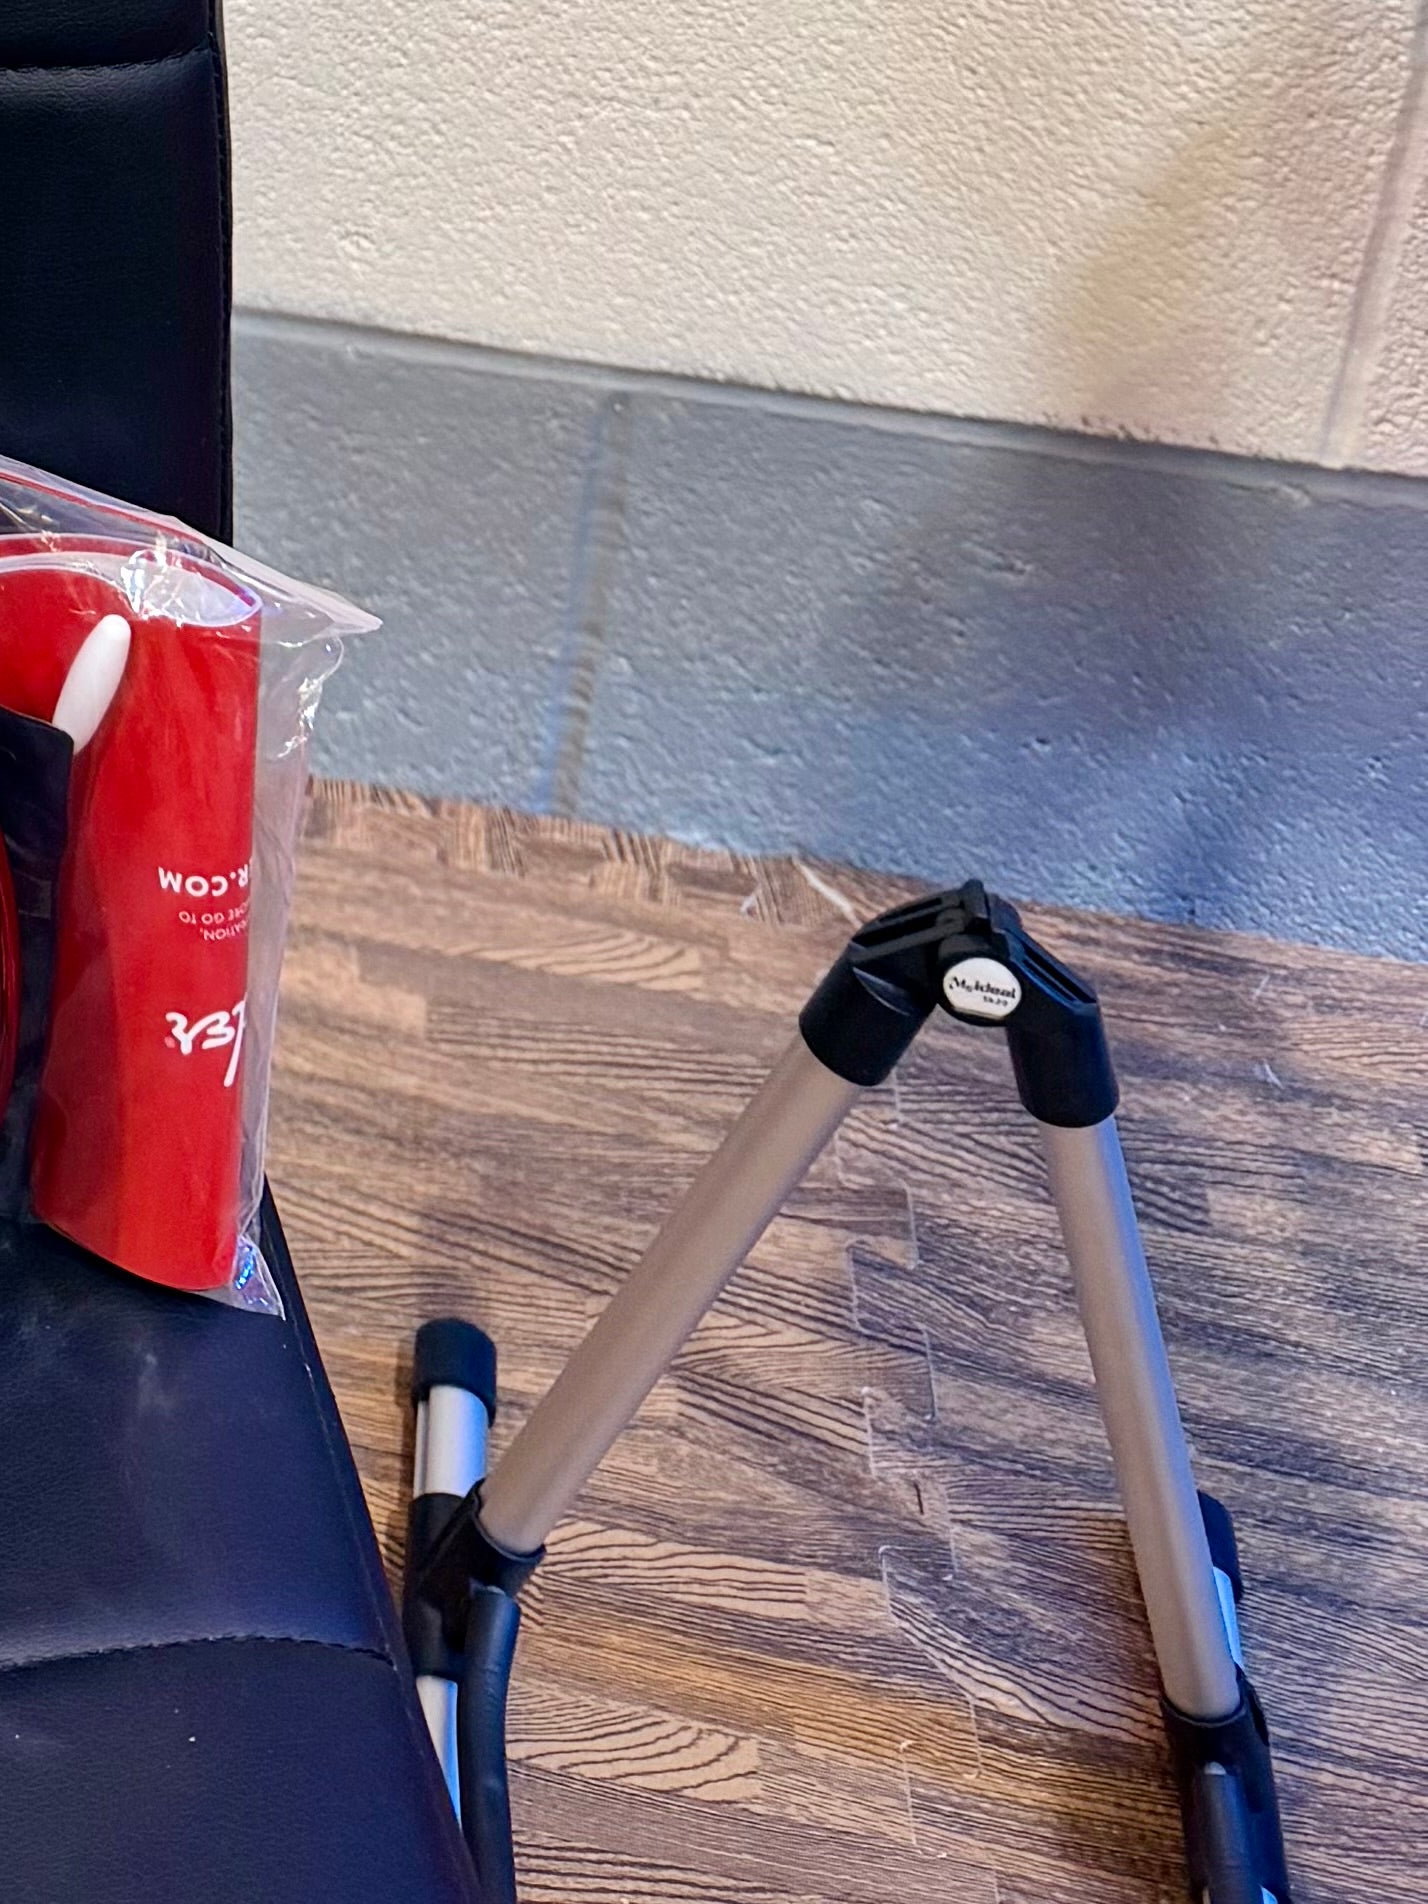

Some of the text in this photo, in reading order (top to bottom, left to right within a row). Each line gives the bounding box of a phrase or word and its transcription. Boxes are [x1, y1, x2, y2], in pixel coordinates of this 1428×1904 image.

[158, 864, 250, 897] R.COM
[178, 910, 197, 924] TO
[201, 910, 225, 925] GO
